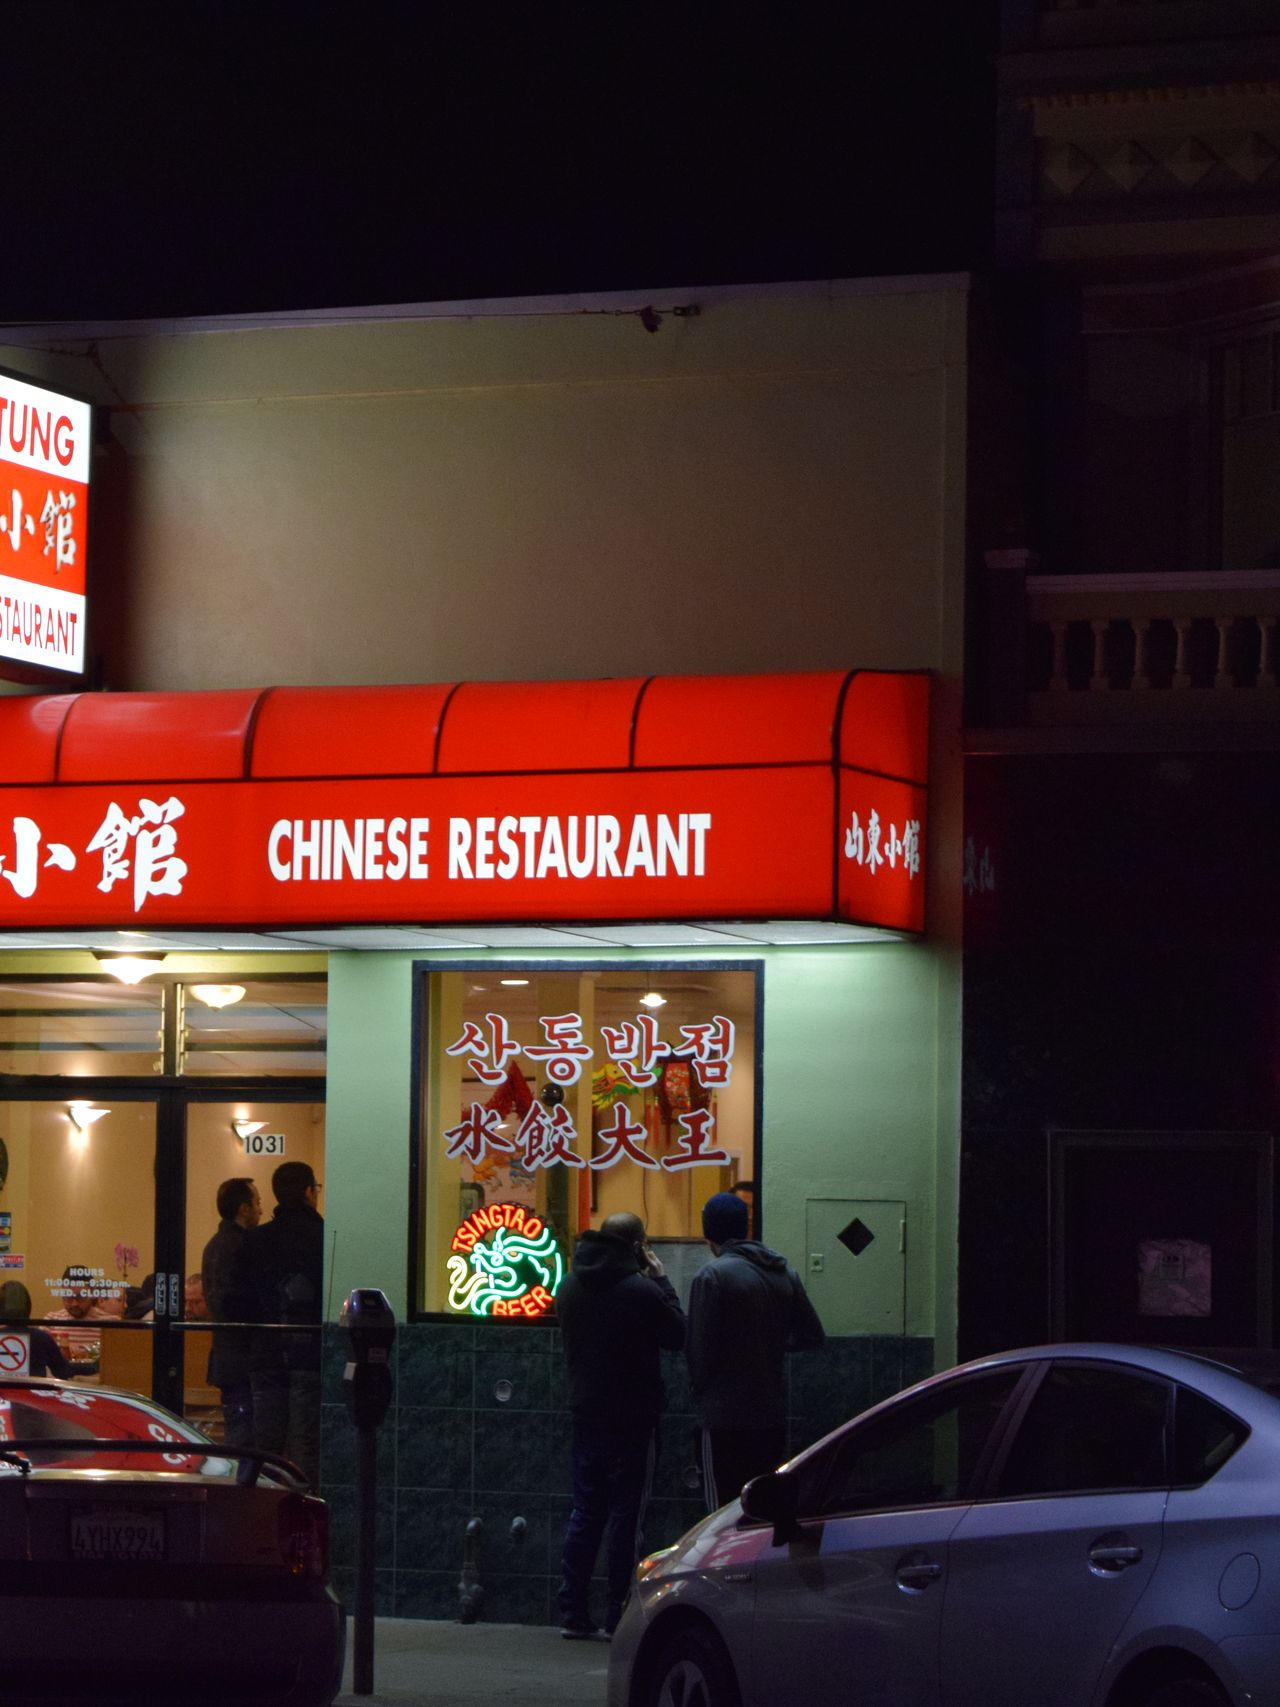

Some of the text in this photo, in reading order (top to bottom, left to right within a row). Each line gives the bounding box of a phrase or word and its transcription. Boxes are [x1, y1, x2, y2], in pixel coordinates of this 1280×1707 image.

[267, 812, 712, 882] CHINESE RESTAURANT
[844, 808, 920, 881] 山東小館
[446, 1013, 735, 1088] 산동반점
[246, 1135, 284, 1153] 1031
[443, 1101, 731, 1172] 水餃大王
[451, 1203, 542, 1253] TSINGTAO
[50, 1289, 121, 1298] WED. CLOSED
[70, 1268, 104, 1276] HOURS
[492, 1285, 553, 1316] BEER
